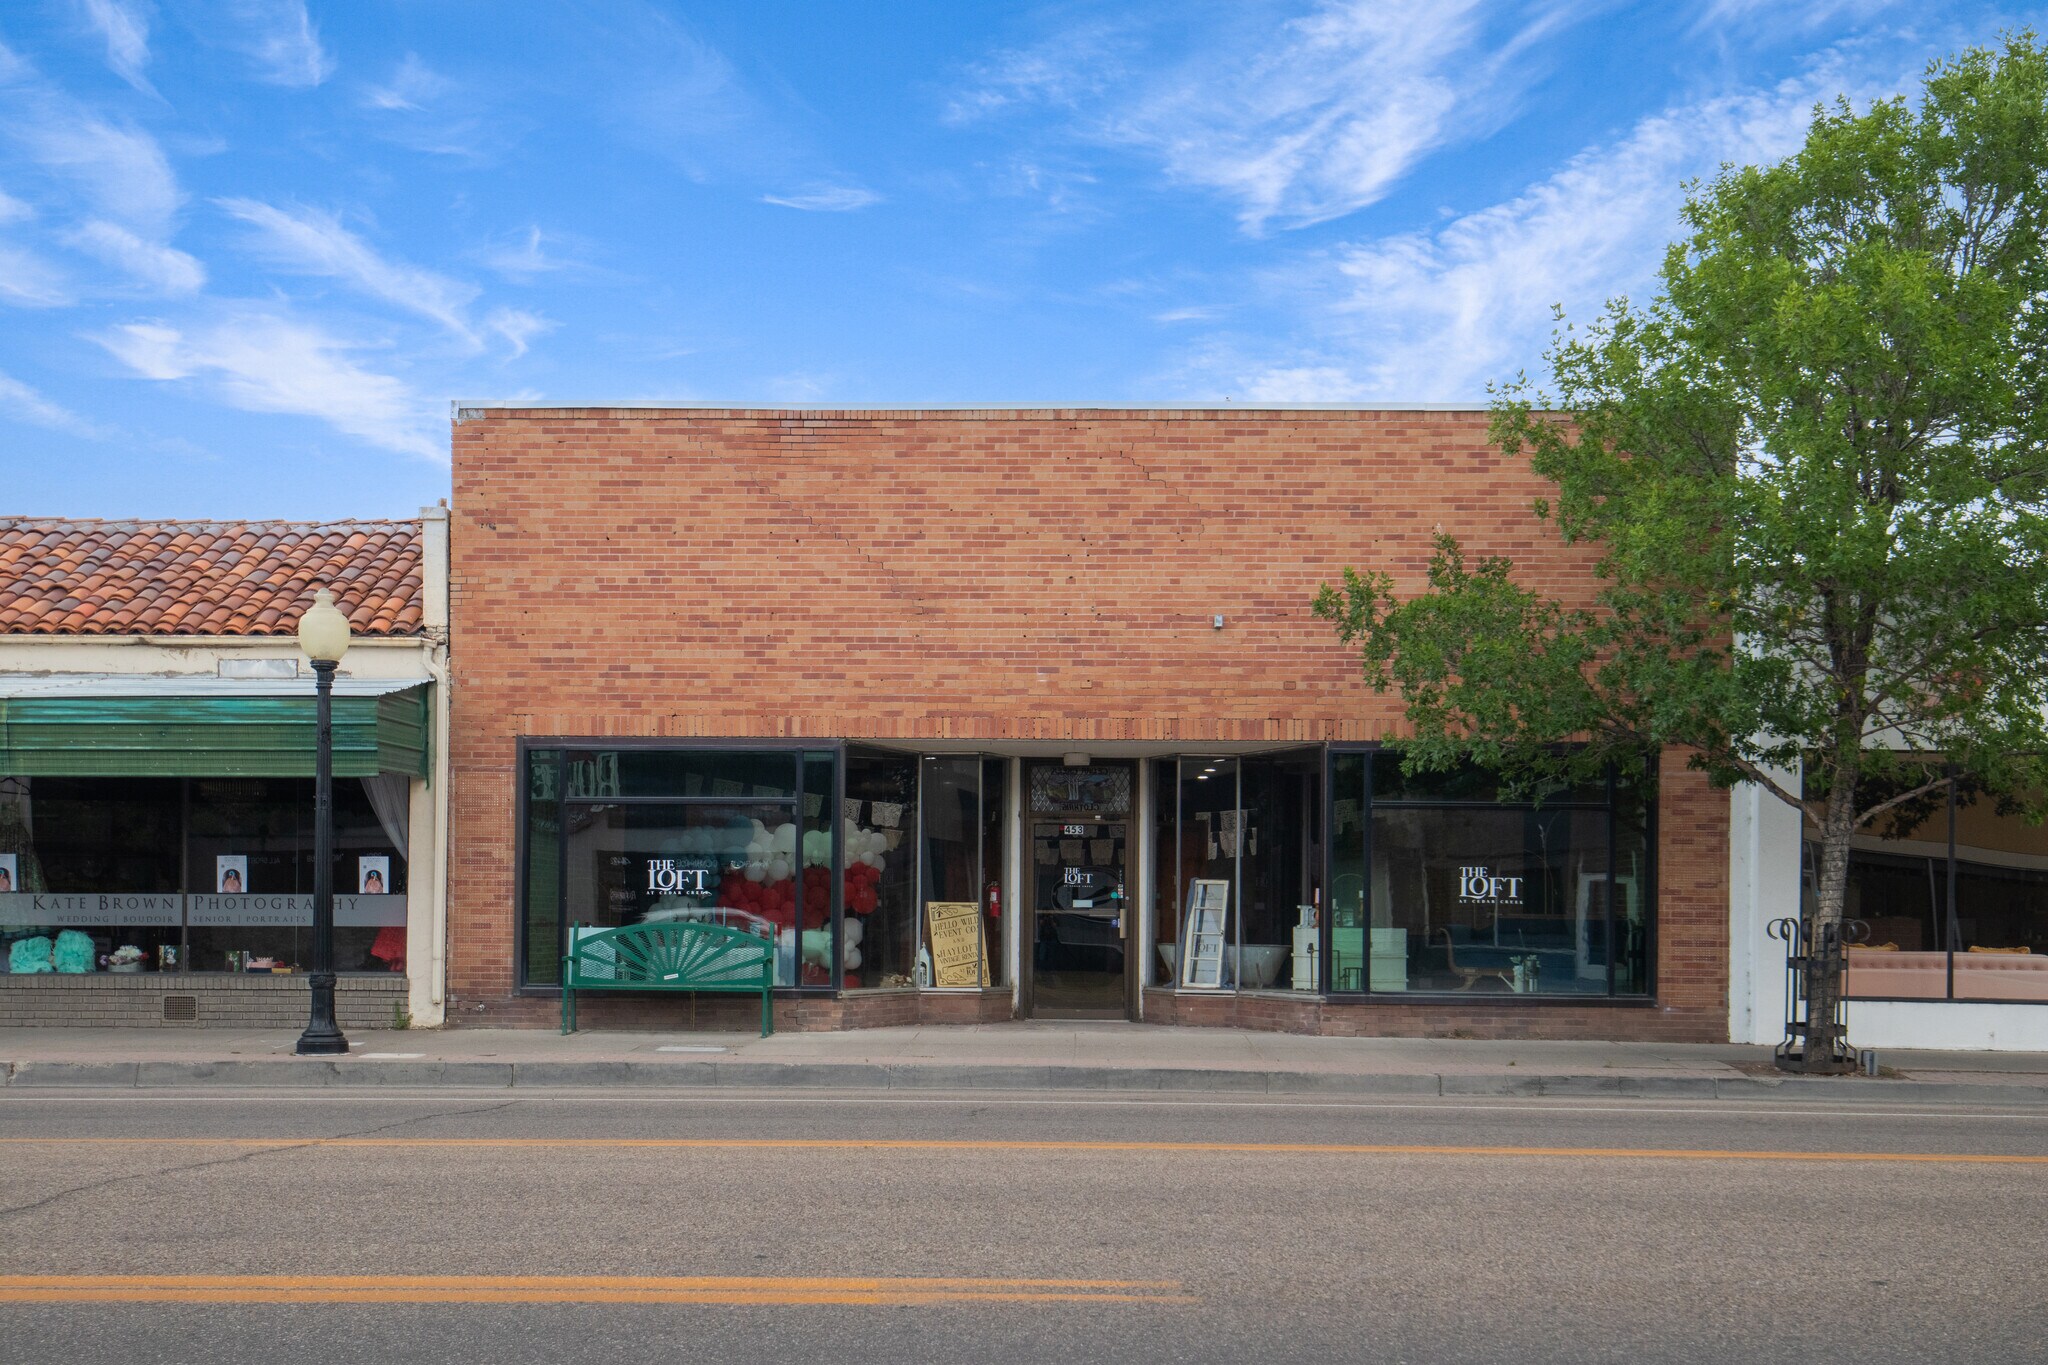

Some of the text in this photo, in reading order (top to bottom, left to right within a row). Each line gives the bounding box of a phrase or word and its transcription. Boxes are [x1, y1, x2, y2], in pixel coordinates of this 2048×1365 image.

[1064, 825, 1083, 834] 453
[647, 859, 675, 870] THE
[1459, 866, 1488, 877] THE
[647, 869, 709, 891] LOFT
[1064, 873, 1093, 884] LOFT
[1459, 876, 1523, 899] LOFT
[32, 895, 358, 910] KATE BROWN PHOTOGRAHY
[57, 915, 307, 923] WEDDING BOUDOIR SENIOR PORTRAITS
[935, 916, 979, 931] HELLO WILD
[939, 927, 962, 939] EVENT
[1196, 943, 1219, 953] OFT
